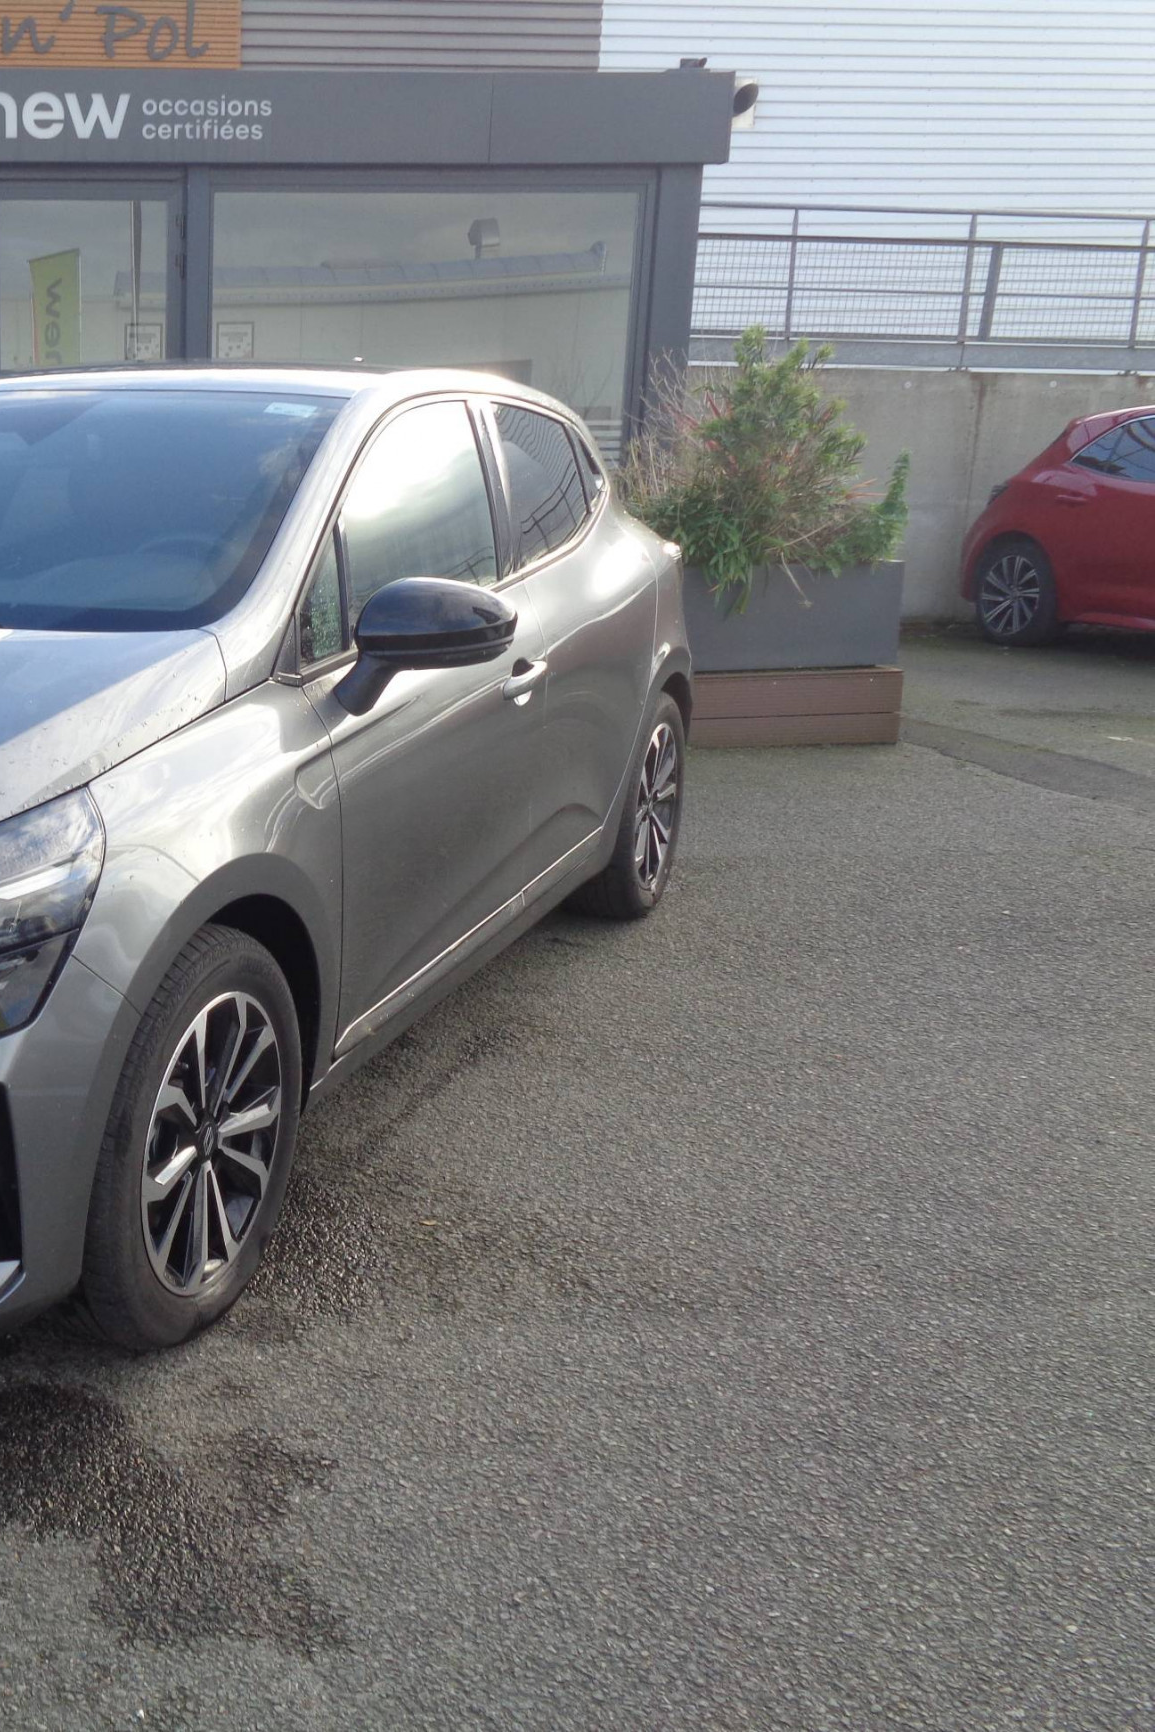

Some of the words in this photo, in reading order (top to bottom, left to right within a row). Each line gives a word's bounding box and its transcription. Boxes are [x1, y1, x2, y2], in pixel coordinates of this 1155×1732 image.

[96, 0, 209, 61] Pol
[141, 95, 273, 116] occasions
[141, 118, 264, 140] certifiées
